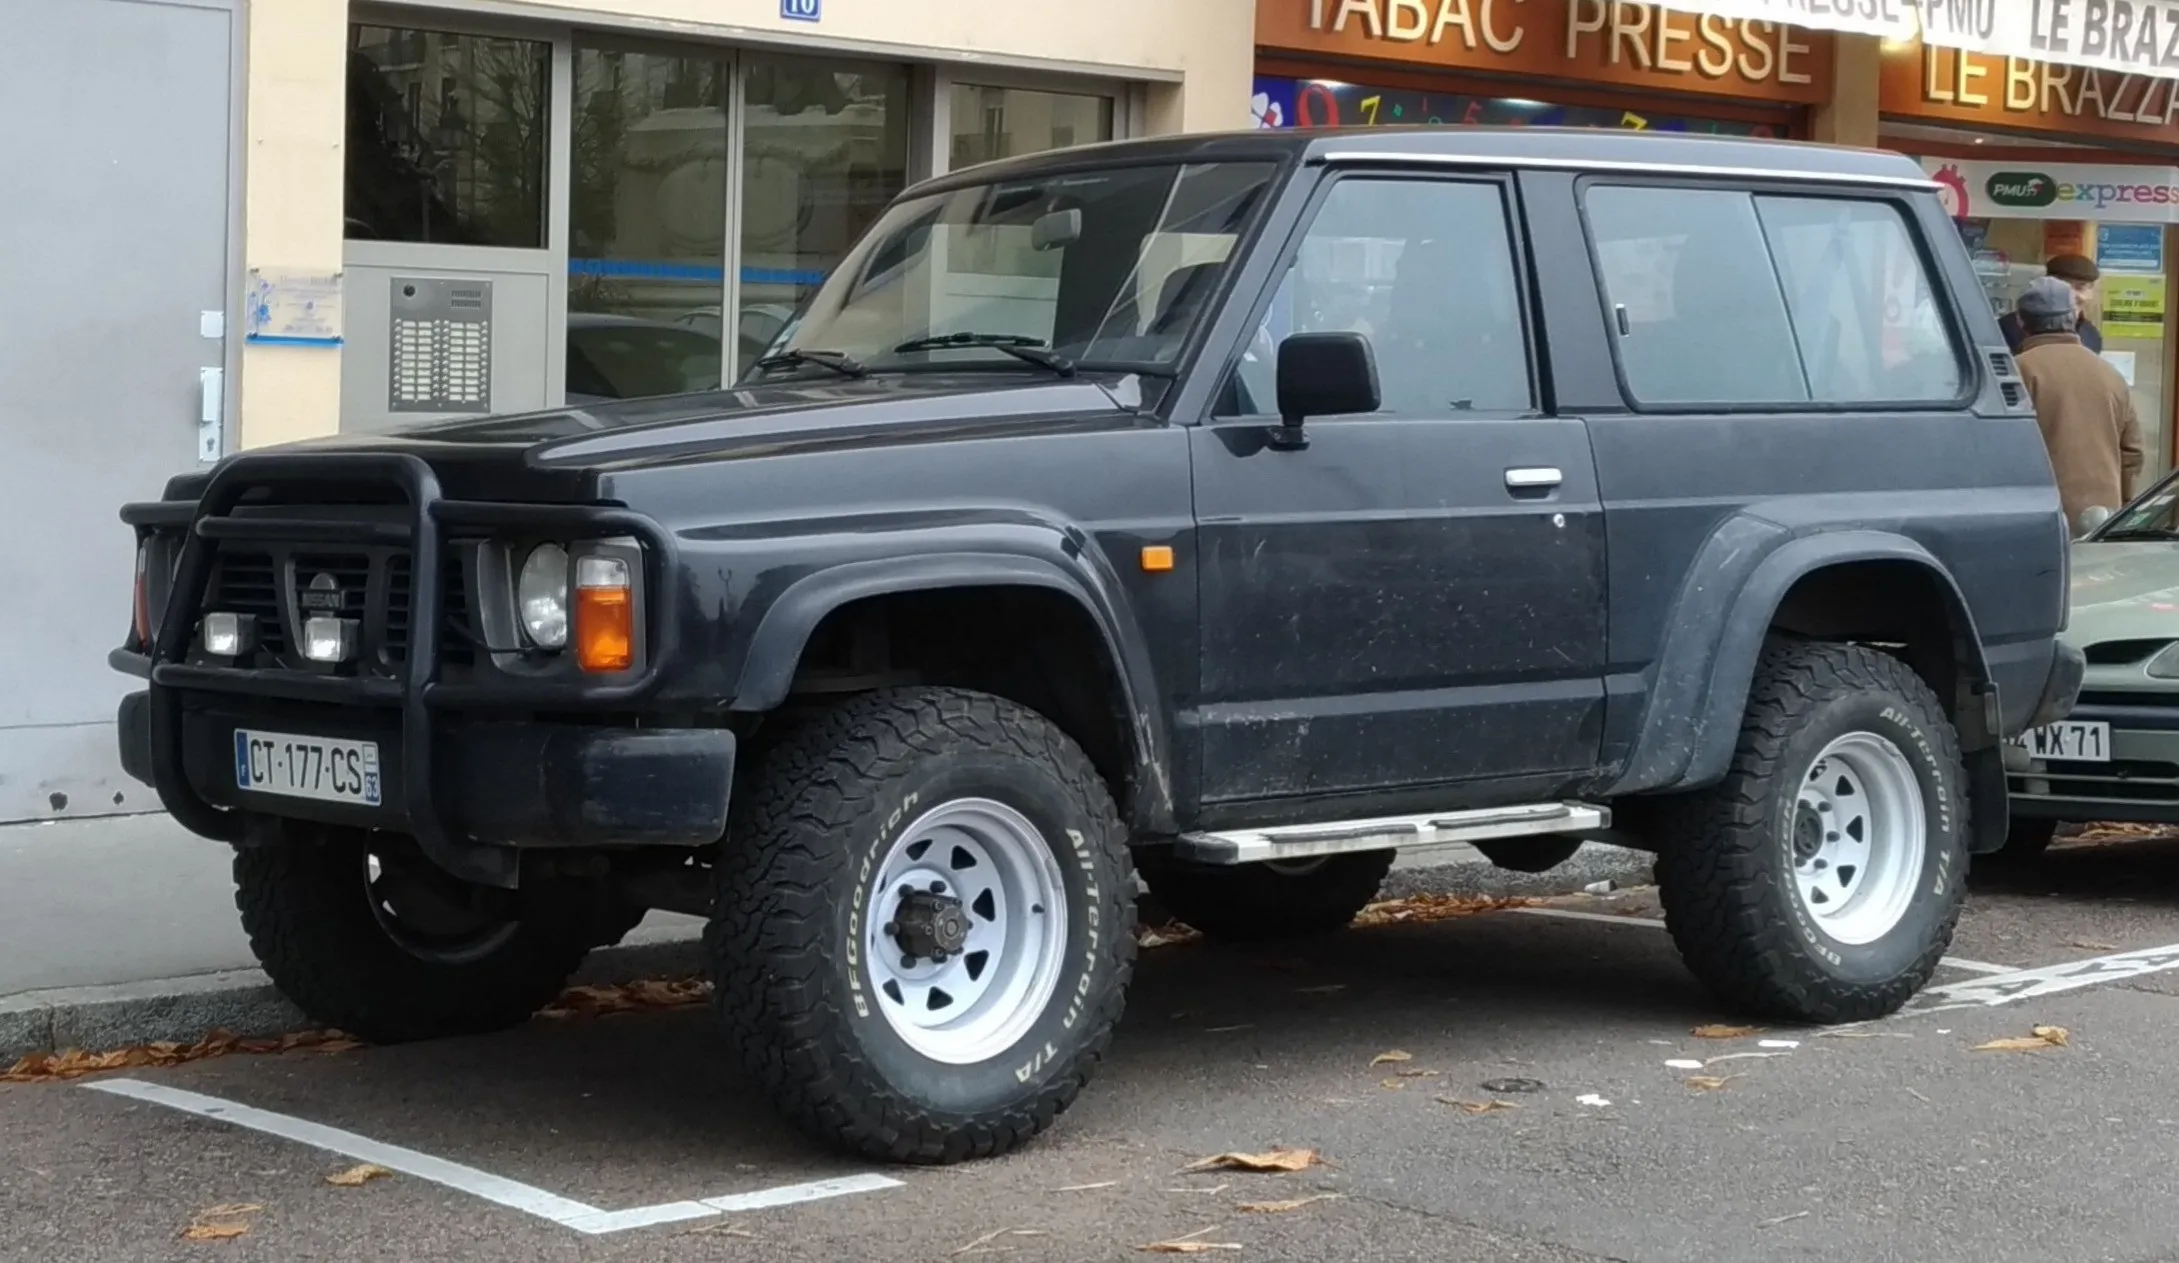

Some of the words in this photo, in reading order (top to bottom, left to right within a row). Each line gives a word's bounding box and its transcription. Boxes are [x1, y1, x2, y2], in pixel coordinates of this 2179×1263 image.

[1566, 0, 1811, 84] PRESSE
[2030, 0, 2070, 53] LE
[1928, 44, 1989, 104] LE
[1992, 183, 2027, 197] PMU
[2056, 182, 2179, 209] express
[2070, 725, 2100, 757] 71
[846, 791, 919, 1018] BFGoodrich
[1063, 827, 1100, 1029] All-Terrain
[1014, 1040, 1058, 1084] T/A
